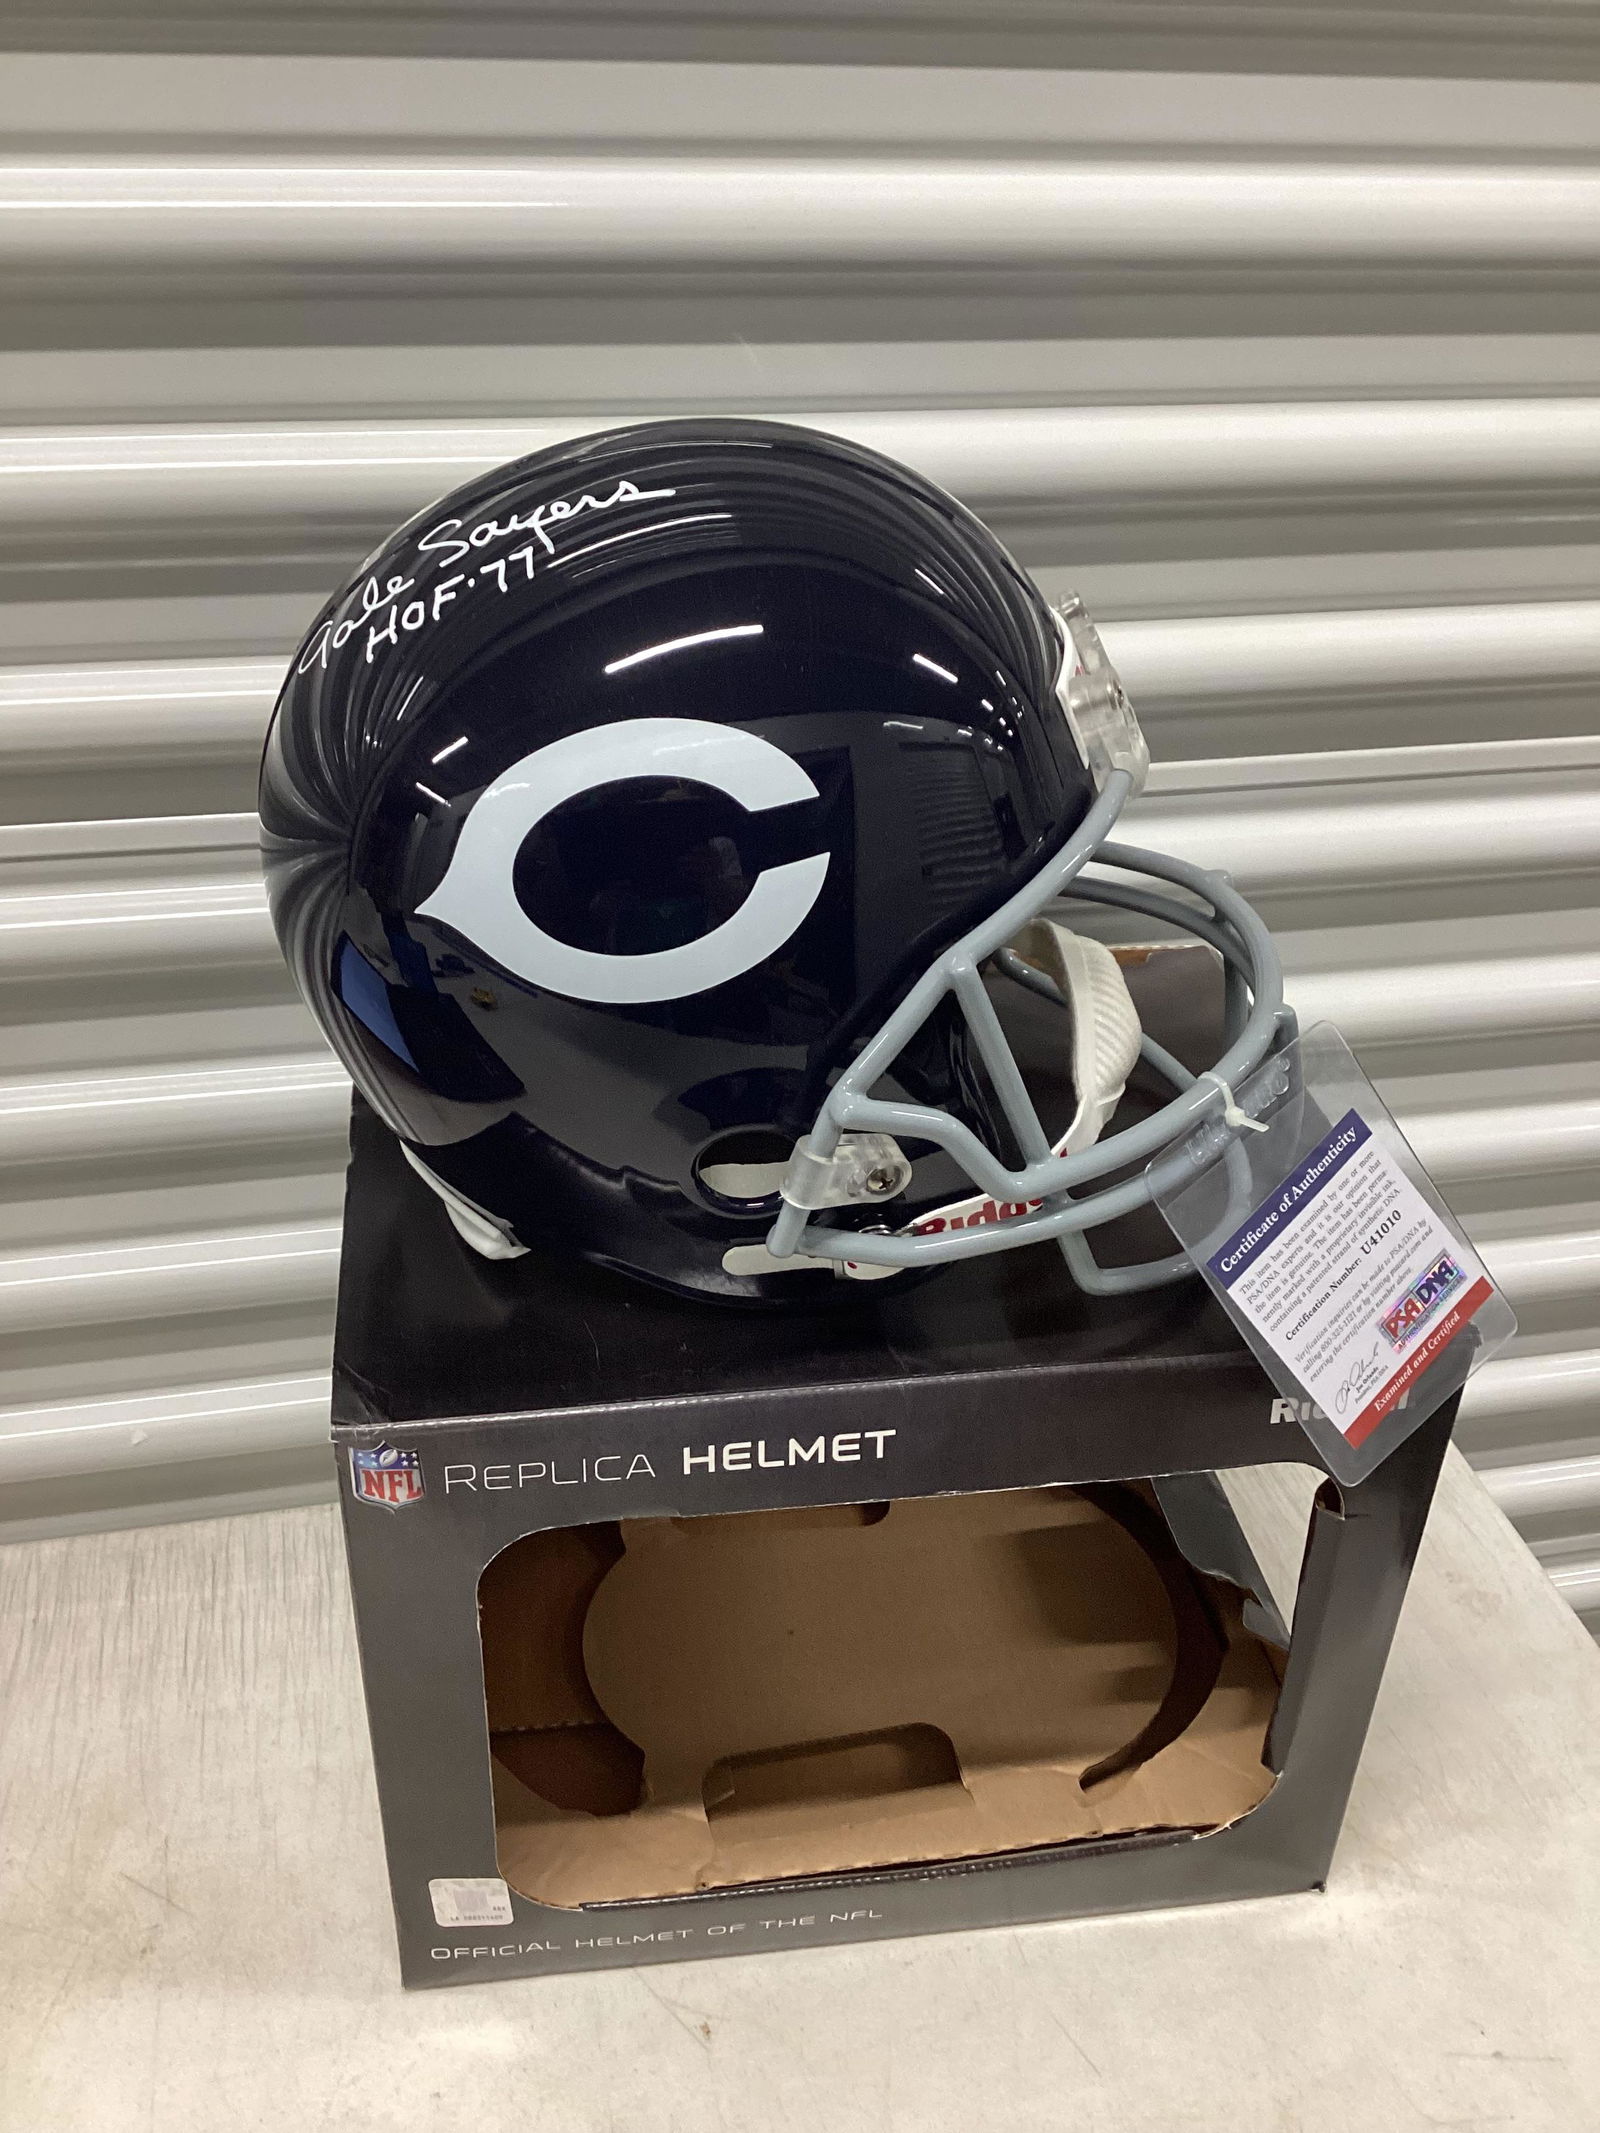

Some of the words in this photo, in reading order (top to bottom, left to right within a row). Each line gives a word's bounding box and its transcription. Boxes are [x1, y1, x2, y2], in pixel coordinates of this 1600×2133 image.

[418, 480, 676, 567] Sayers
[414, 717, 831, 1004] C
[1220, 1211, 1278, 1271] Certificate
[1278, 1192, 1293, 1212] of
[1291, 1126, 1355, 1200] Authenticity
[1238, 1278, 1256, 1294] This
[1254, 1262, 1271, 1278] item
[1269, 1248, 1283, 1262] has
[1282, 1232, 1299, 1249] been
[1299, 1199, 1328, 1232] examined
[1326, 1190, 1337, 1201] by
[1337, 1177, 1349, 1190] one
[1350, 1167, 1358, 1177] or
[1358, 1151, 1374, 1168] more
[1246, 1270, 1280, 1304] PSA/DNA
[1280, 1244, 1303, 1269] experts
[1304, 1228, 1317, 1244] and
[1317, 1221, 1324, 1229] it
[1324, 1213, 1331, 1222] is
[1332, 1200, 1343, 1213] our
[1345, 1174, 1368, 1199] opinion
[1367, 1159, 1381, 1174] that
[1254, 1301, 1266, 1313] the
[1265, 1285, 1281, 1301] item
[1280, 1277, 1288, 1285] is
[1312, 1235, 1327, 1249] The
[1326, 1219, 1342, 1235] item
[1340, 1207, 1353, 1220] has
[1351, 1191, 1368, 1208] been
[1262, 1299, 1282, 1322] nently
[1282, 1273, 1305, 1300] marked
[1304, 1259, 1320, 1275] with
[1325, 1217, 1358, 1255] proprietary
[1357, 1191, 1383, 1219] invisible
[1269, 1295, 1302, 1331] containing
[1305, 1261, 1332, 1293] patented
[1331, 1240, 1351, 1264] strand
[1350, 1232, 1358, 1243] of
[1357, 1205, 1384, 1236] synthetic
[1285, 1291, 1331, 1340] Certification
[1328, 1257, 1361, 1292] Number:
[1359, 1209, 1401, 1254] U41010
[1386, 1297, 1422, 1340] PSA
[1416, 1260, 1456, 1306] DNA
[1294, 1326, 1328, 1362] Verification
[1327, 1299, 1352, 1328] inquiries
[1351, 1288, 1363, 1301] can
[1302, 1350, 1322, 1373] calling
[1332, 1343, 1342, 1356] the
[1373, 1364, 1412, 1411] Examined
[1413, 1347, 1428, 1368] and
[1427, 1310, 1460, 1349] Certified
[362, 1469, 422, 1503] NFL
[445, 1453, 656, 1494] REPLICA
[682, 1429, 897, 1475] HELMET
[431, 1940, 561, 1960] OFFICIAL
[575, 1929, 694, 1949] HELMET
[707, 1923, 746, 1936] OF
[759, 1914, 816, 1930] THE
[829, 1909, 883, 1924] NFL
